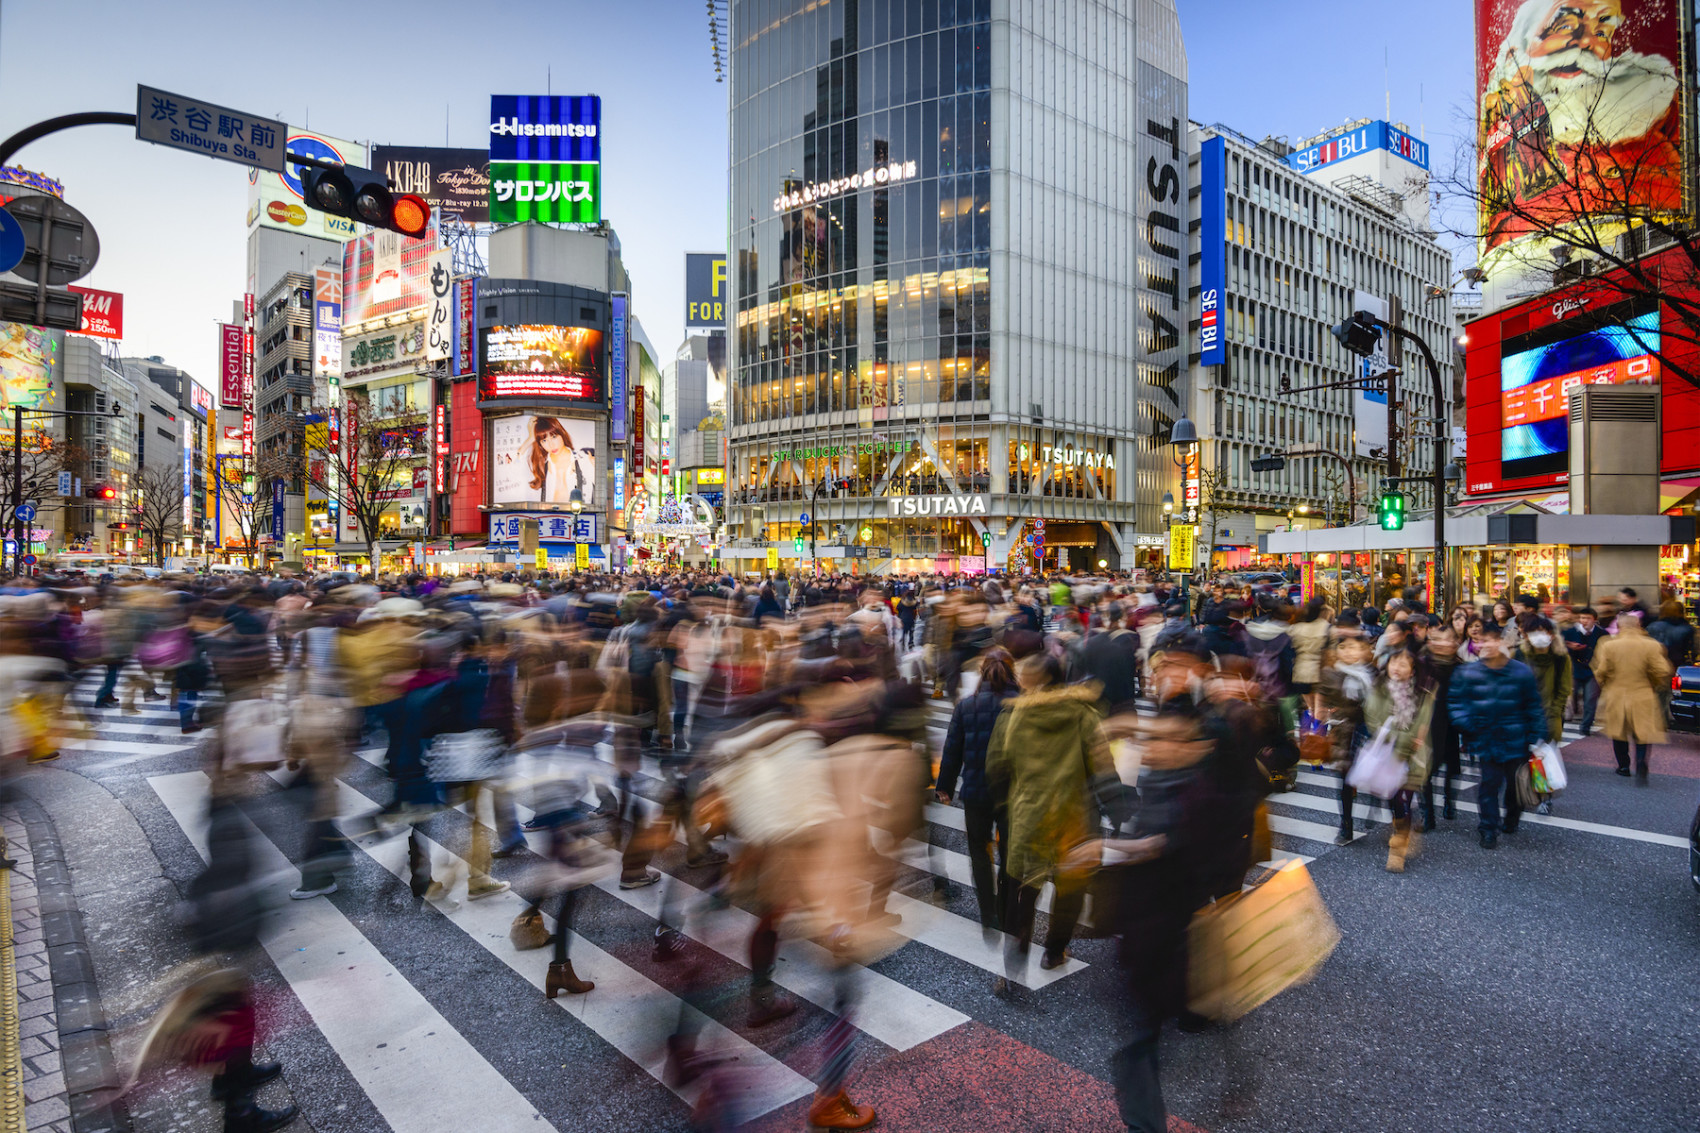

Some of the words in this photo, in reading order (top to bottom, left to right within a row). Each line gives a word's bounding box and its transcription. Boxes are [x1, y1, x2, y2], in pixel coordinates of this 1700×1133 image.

[151, 97, 276, 149] 渋谷駅前
[490, 116, 597, 137] Hisamitsu
[170, 128, 228, 154] Shibuya
[233, 143, 261, 162] Sta.
[1296, 129, 1368, 173] SEIBU
[1388, 129, 1426, 166] SEIBU
[386, 161, 430, 194] AKB48
[493, 179, 593, 203] サロンパス
[268, 206, 307, 222] MasterCard
[327, 217, 356, 235] VISA
[1147, 116, 1180, 450] TSUTAYA
[90, 317, 110, 326] この先
[430, 261, 450, 355] もんじゃ
[689, 301, 727, 321] FOR
[1202, 288, 1217, 353] SEIBU
[90, 323, 117, 335] 150m
[223, 326, 240, 403] Essential
[772, 445, 849, 462] STARBUCKS
[858, 440, 912, 455] COFFEE
[1042, 446, 1115, 470] TSUTAYA
[453, 439, 480, 493] クスリ
[890, 495, 986, 516] TSUTAYA
